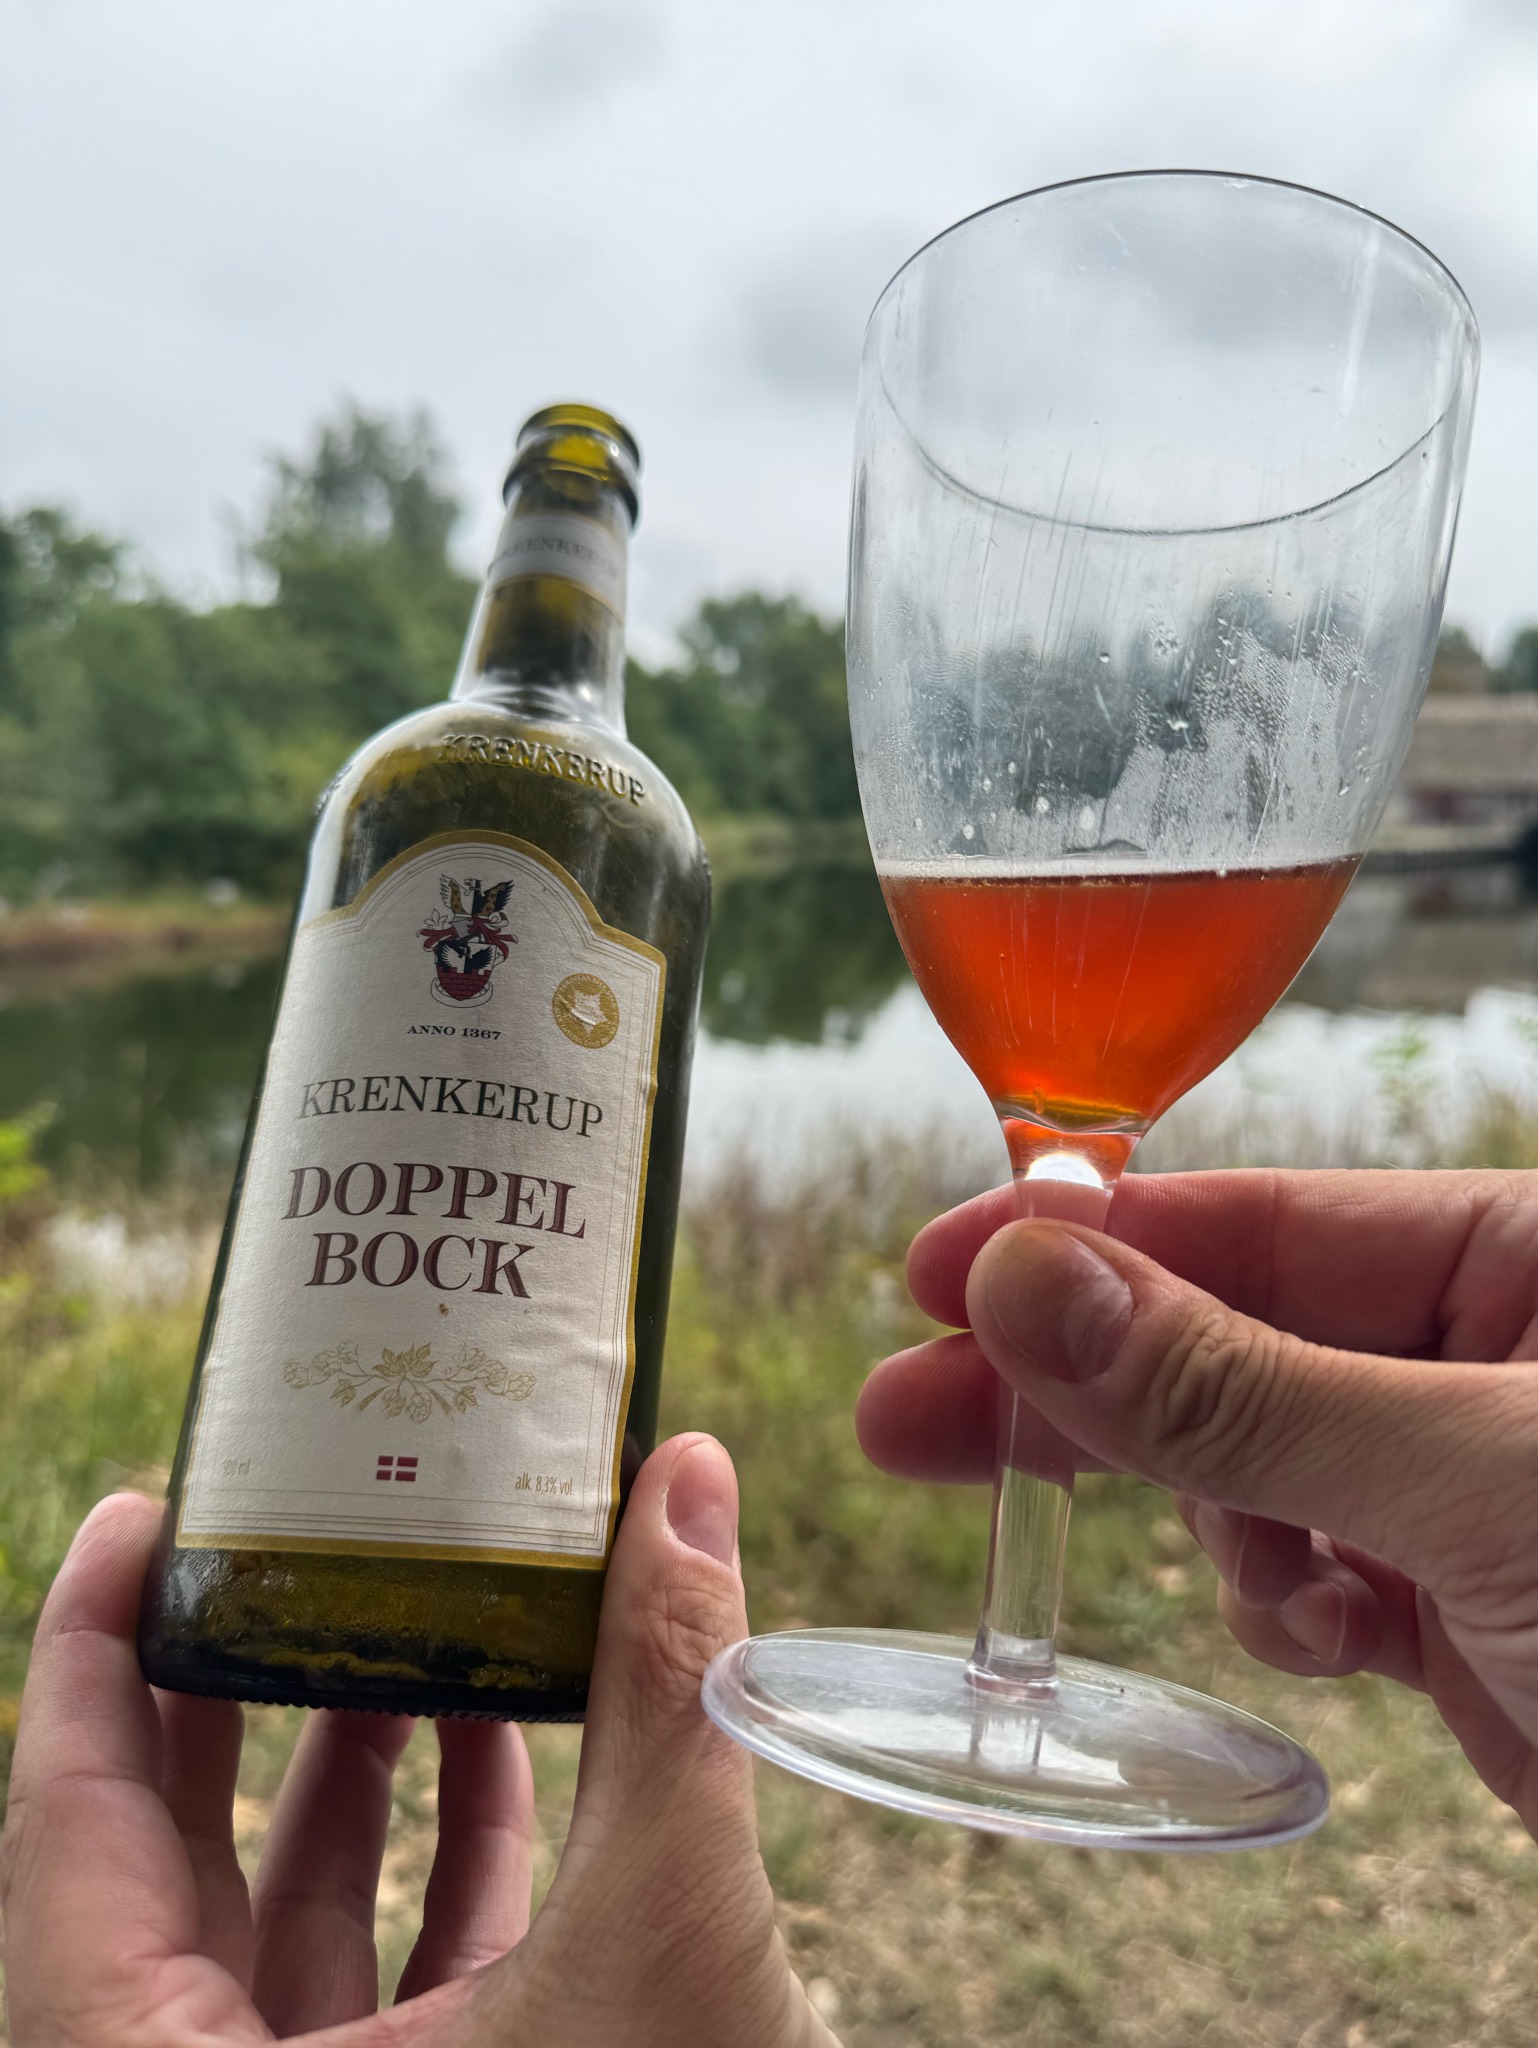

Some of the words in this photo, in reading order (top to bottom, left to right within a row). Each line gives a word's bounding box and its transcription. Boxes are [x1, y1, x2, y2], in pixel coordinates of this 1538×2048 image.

[437, 734, 645, 807] KRENKERUP
[406, 1024, 456, 1036] ANNO
[461, 1026, 501, 1041] 1367
[298, 1075, 603, 1138] KRENKERUP
[281, 1162, 586, 1239] DOPPEL
[304, 1231, 536, 1300] BOCK
[515, 1471, 533, 1491] alk.
[535, 1474, 558, 1495] 8,3%
[559, 1477, 575, 1496] vol.
